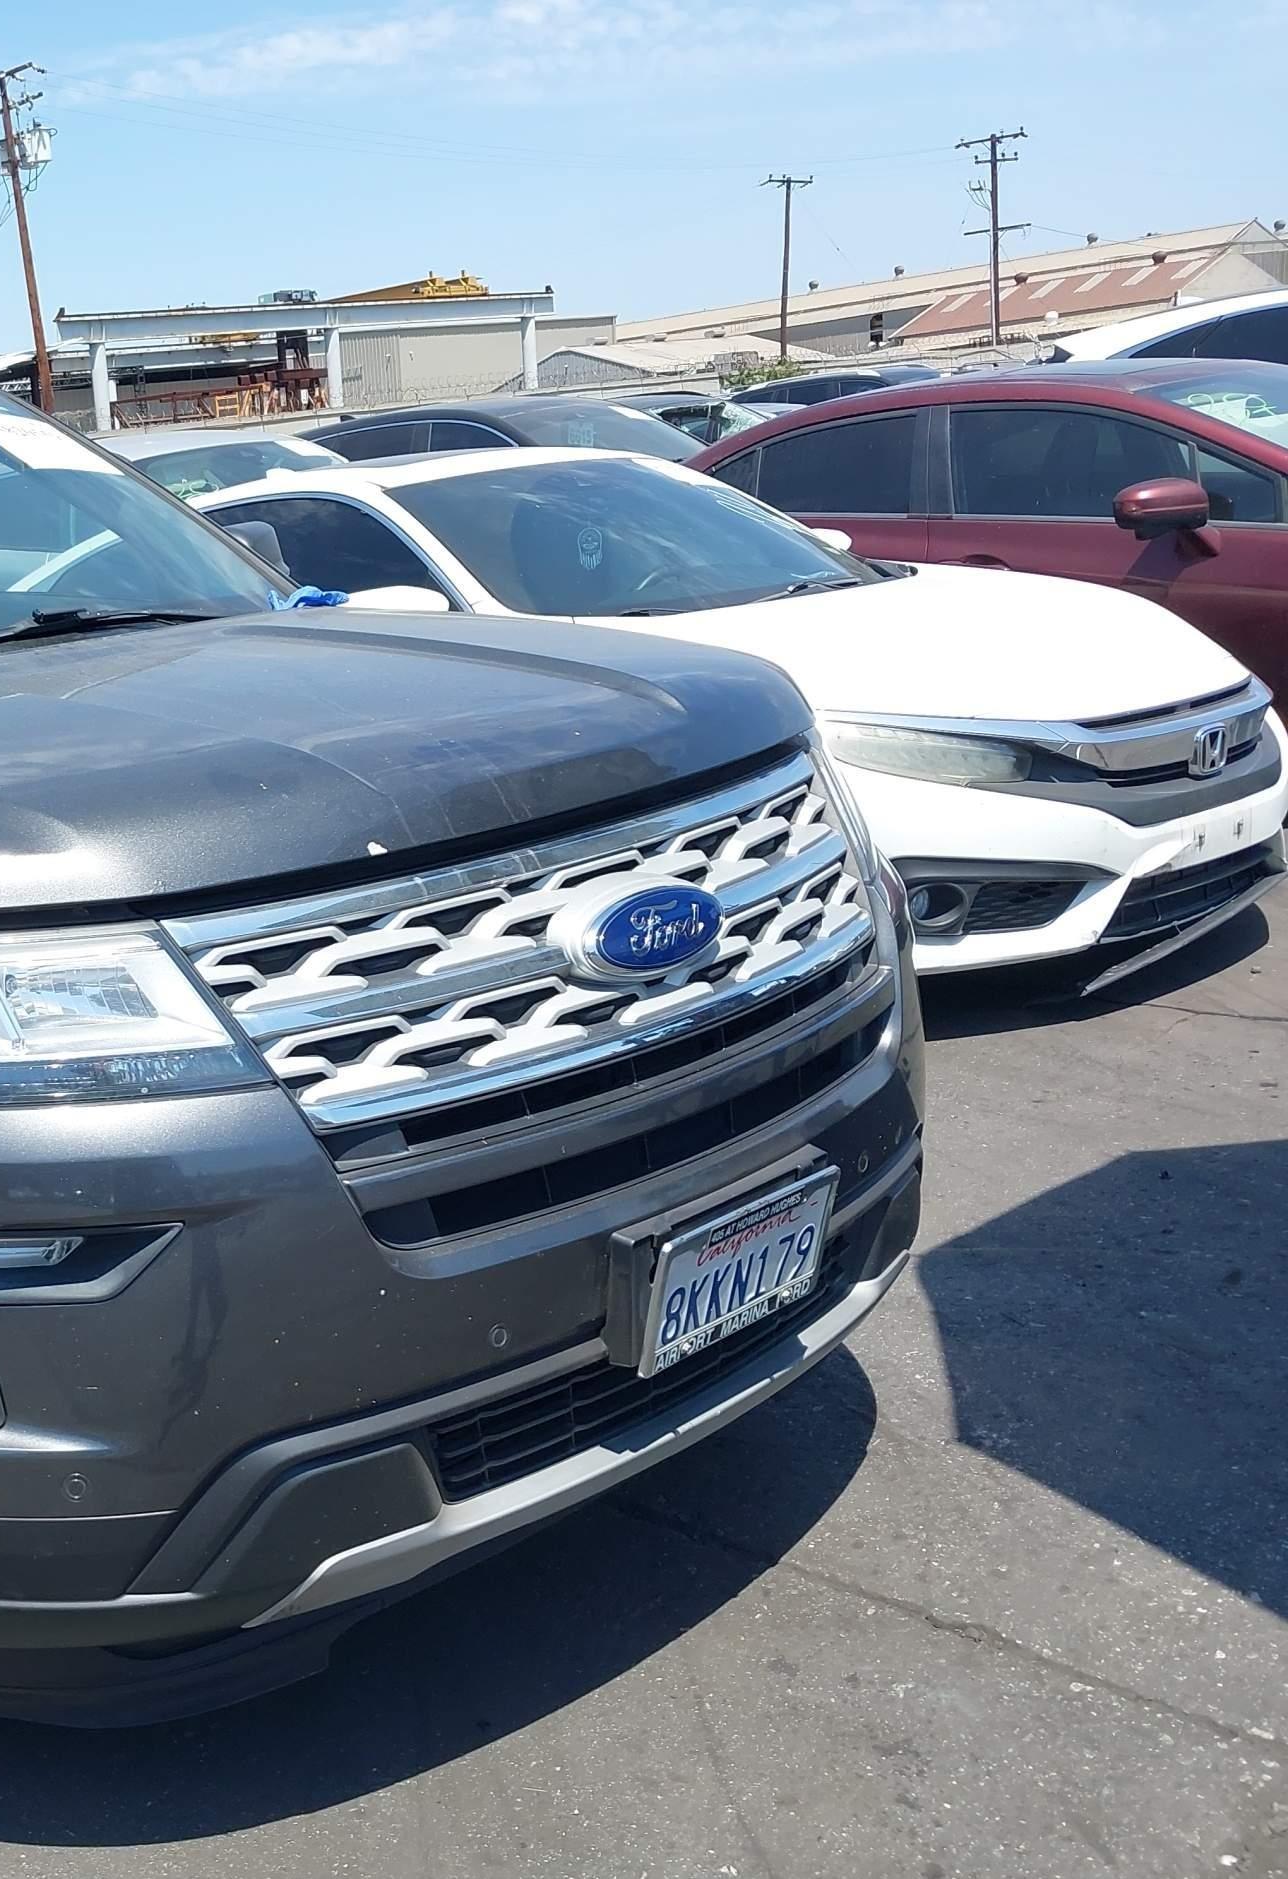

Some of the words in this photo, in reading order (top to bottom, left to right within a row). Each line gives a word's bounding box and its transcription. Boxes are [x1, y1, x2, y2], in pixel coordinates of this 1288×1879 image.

[630, 899, 705, 958] Ford
[696, 1210, 801, 1267] California
[735, 1206, 770, 1232] HOWARD
[770, 1192, 802, 1215] HUGHES
[662, 1225, 816, 1345] 8KKN179
[719, 1301, 770, 1339] MARINA
